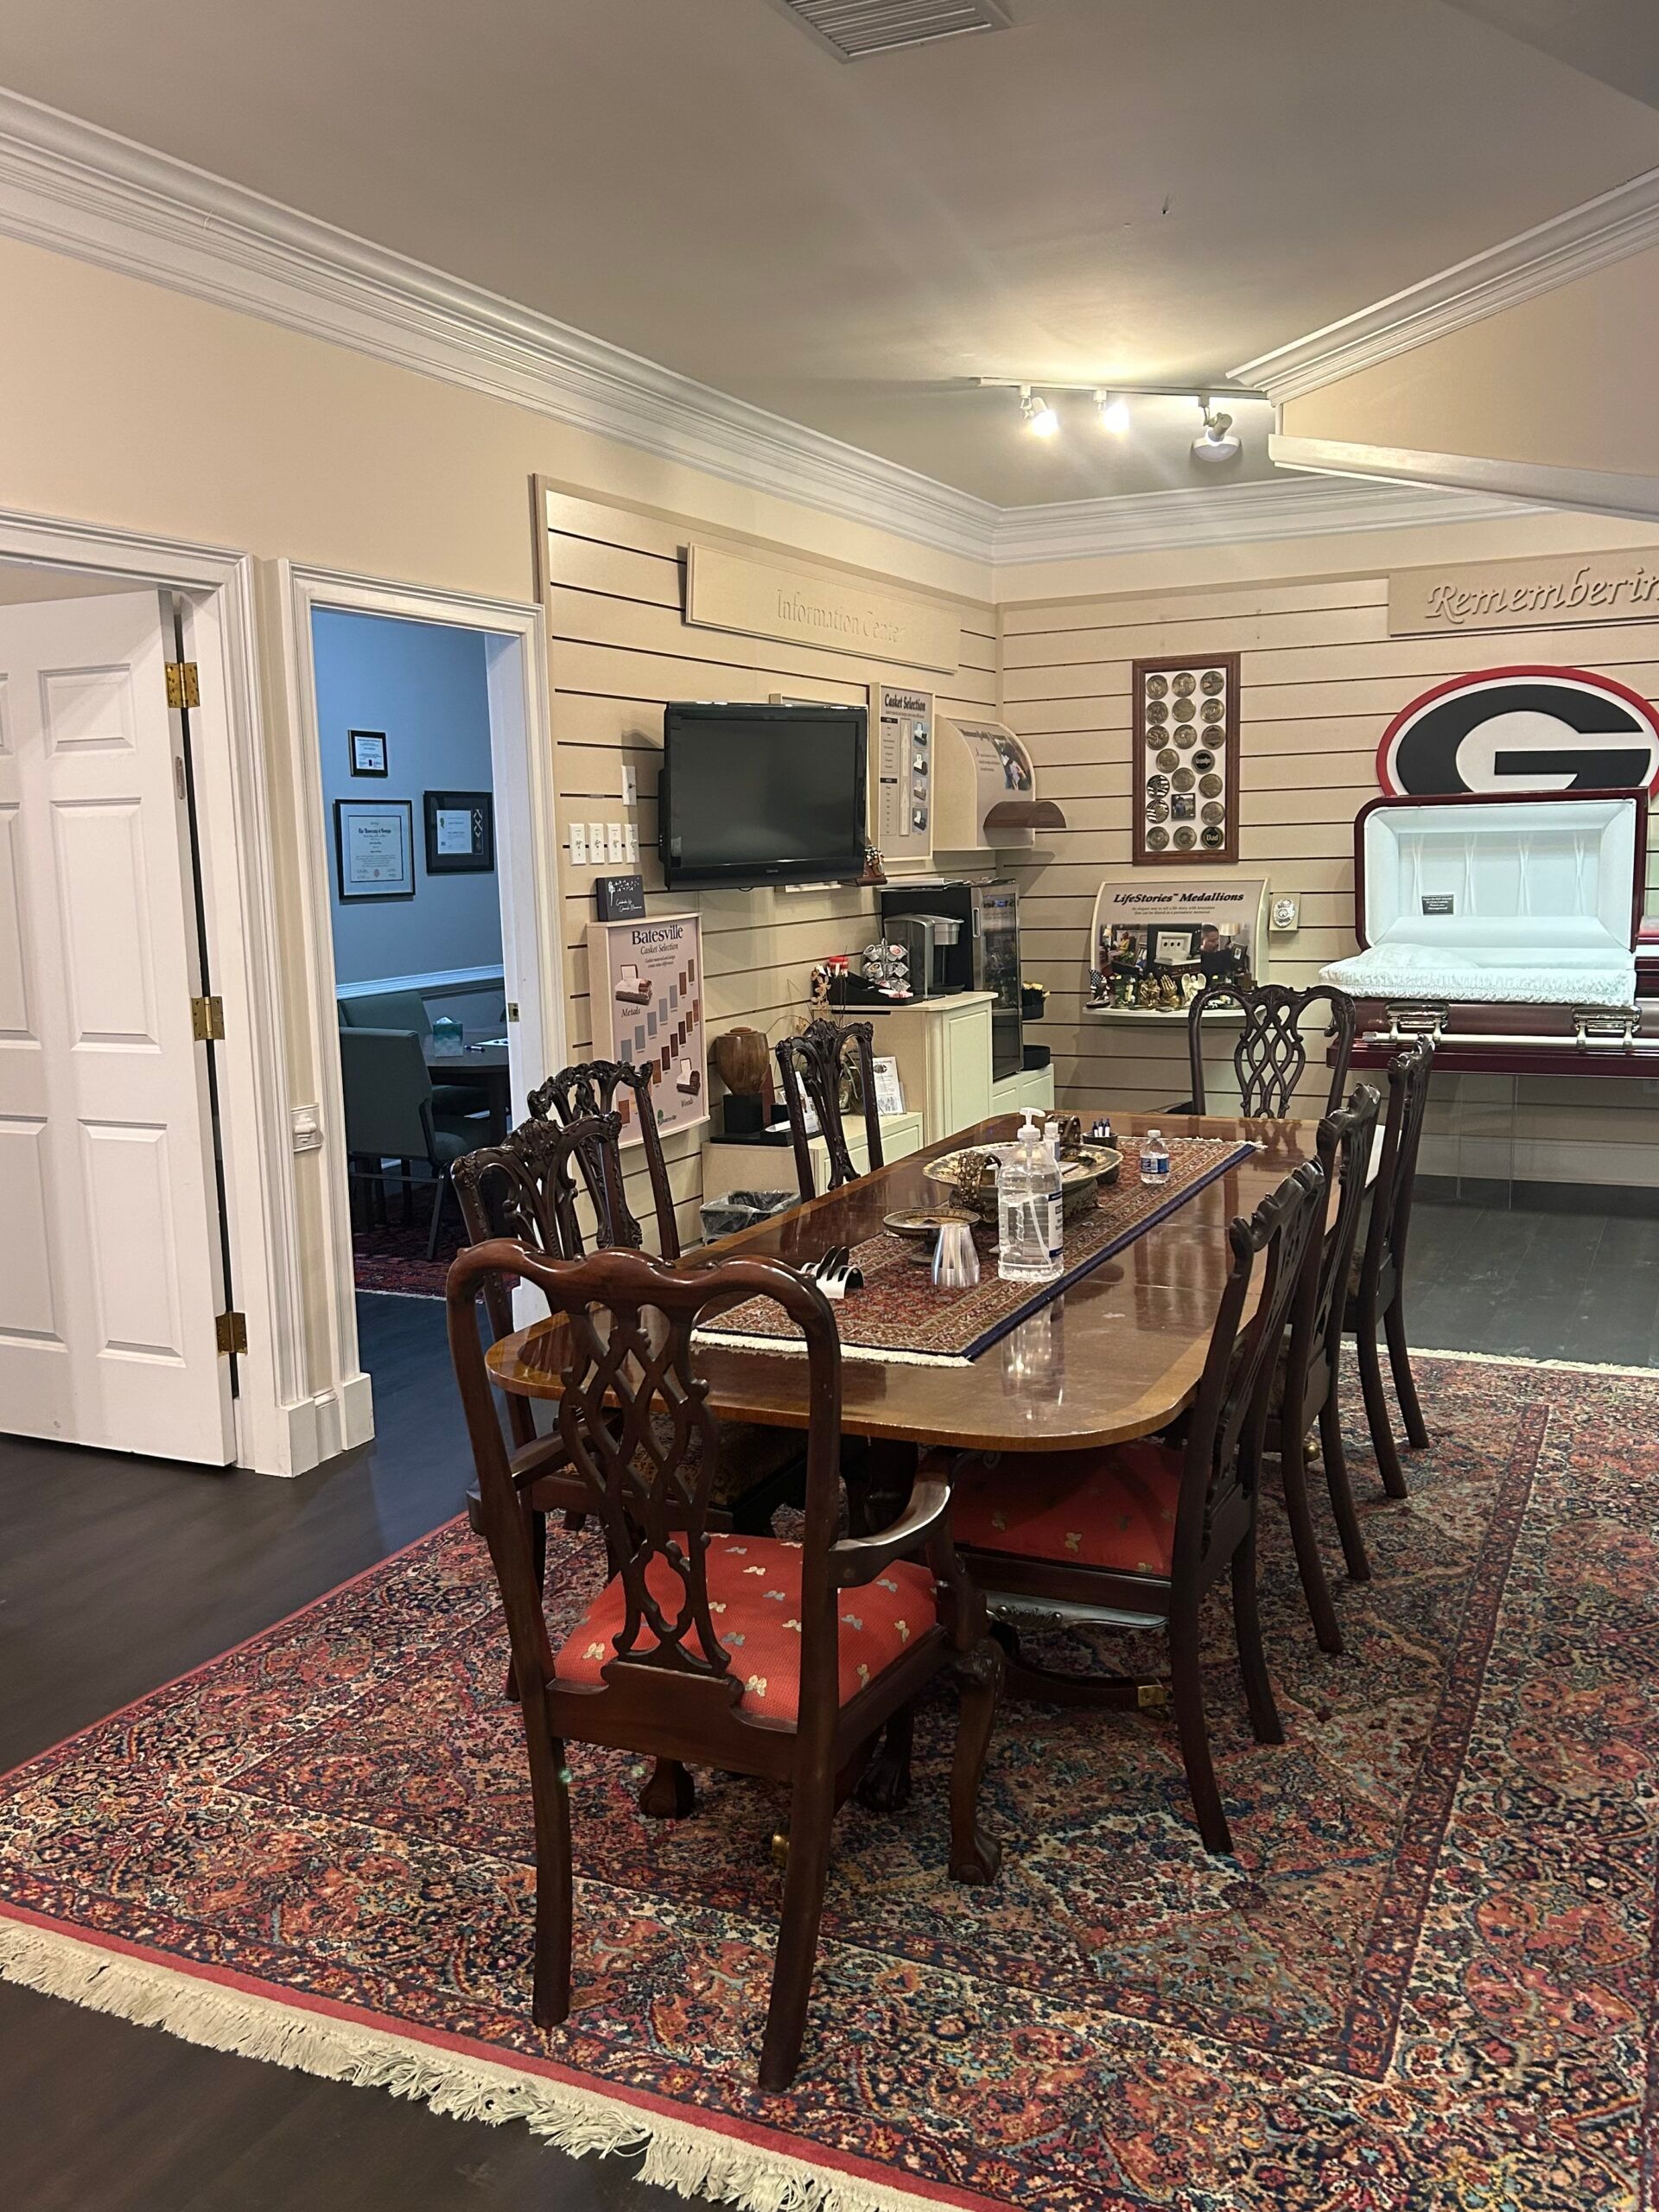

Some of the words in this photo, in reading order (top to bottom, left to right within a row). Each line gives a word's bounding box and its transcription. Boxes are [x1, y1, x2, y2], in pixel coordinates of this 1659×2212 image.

[777, 589, 860, 635] Information
[863, 611, 906, 642] Center
[884, 693, 903, 709] Casket
[903, 696, 926, 712] Selection
[1395, 683, 1651, 796] G
[1206, 832, 1218, 842] Dad
[1179, 893, 1244, 902] Medallions
[632, 924, 683, 945] Batesville
[640, 944, 658, 955] Casket
[658, 942, 679, 952] Selection
[620, 1007, 641, 1018] Metals
